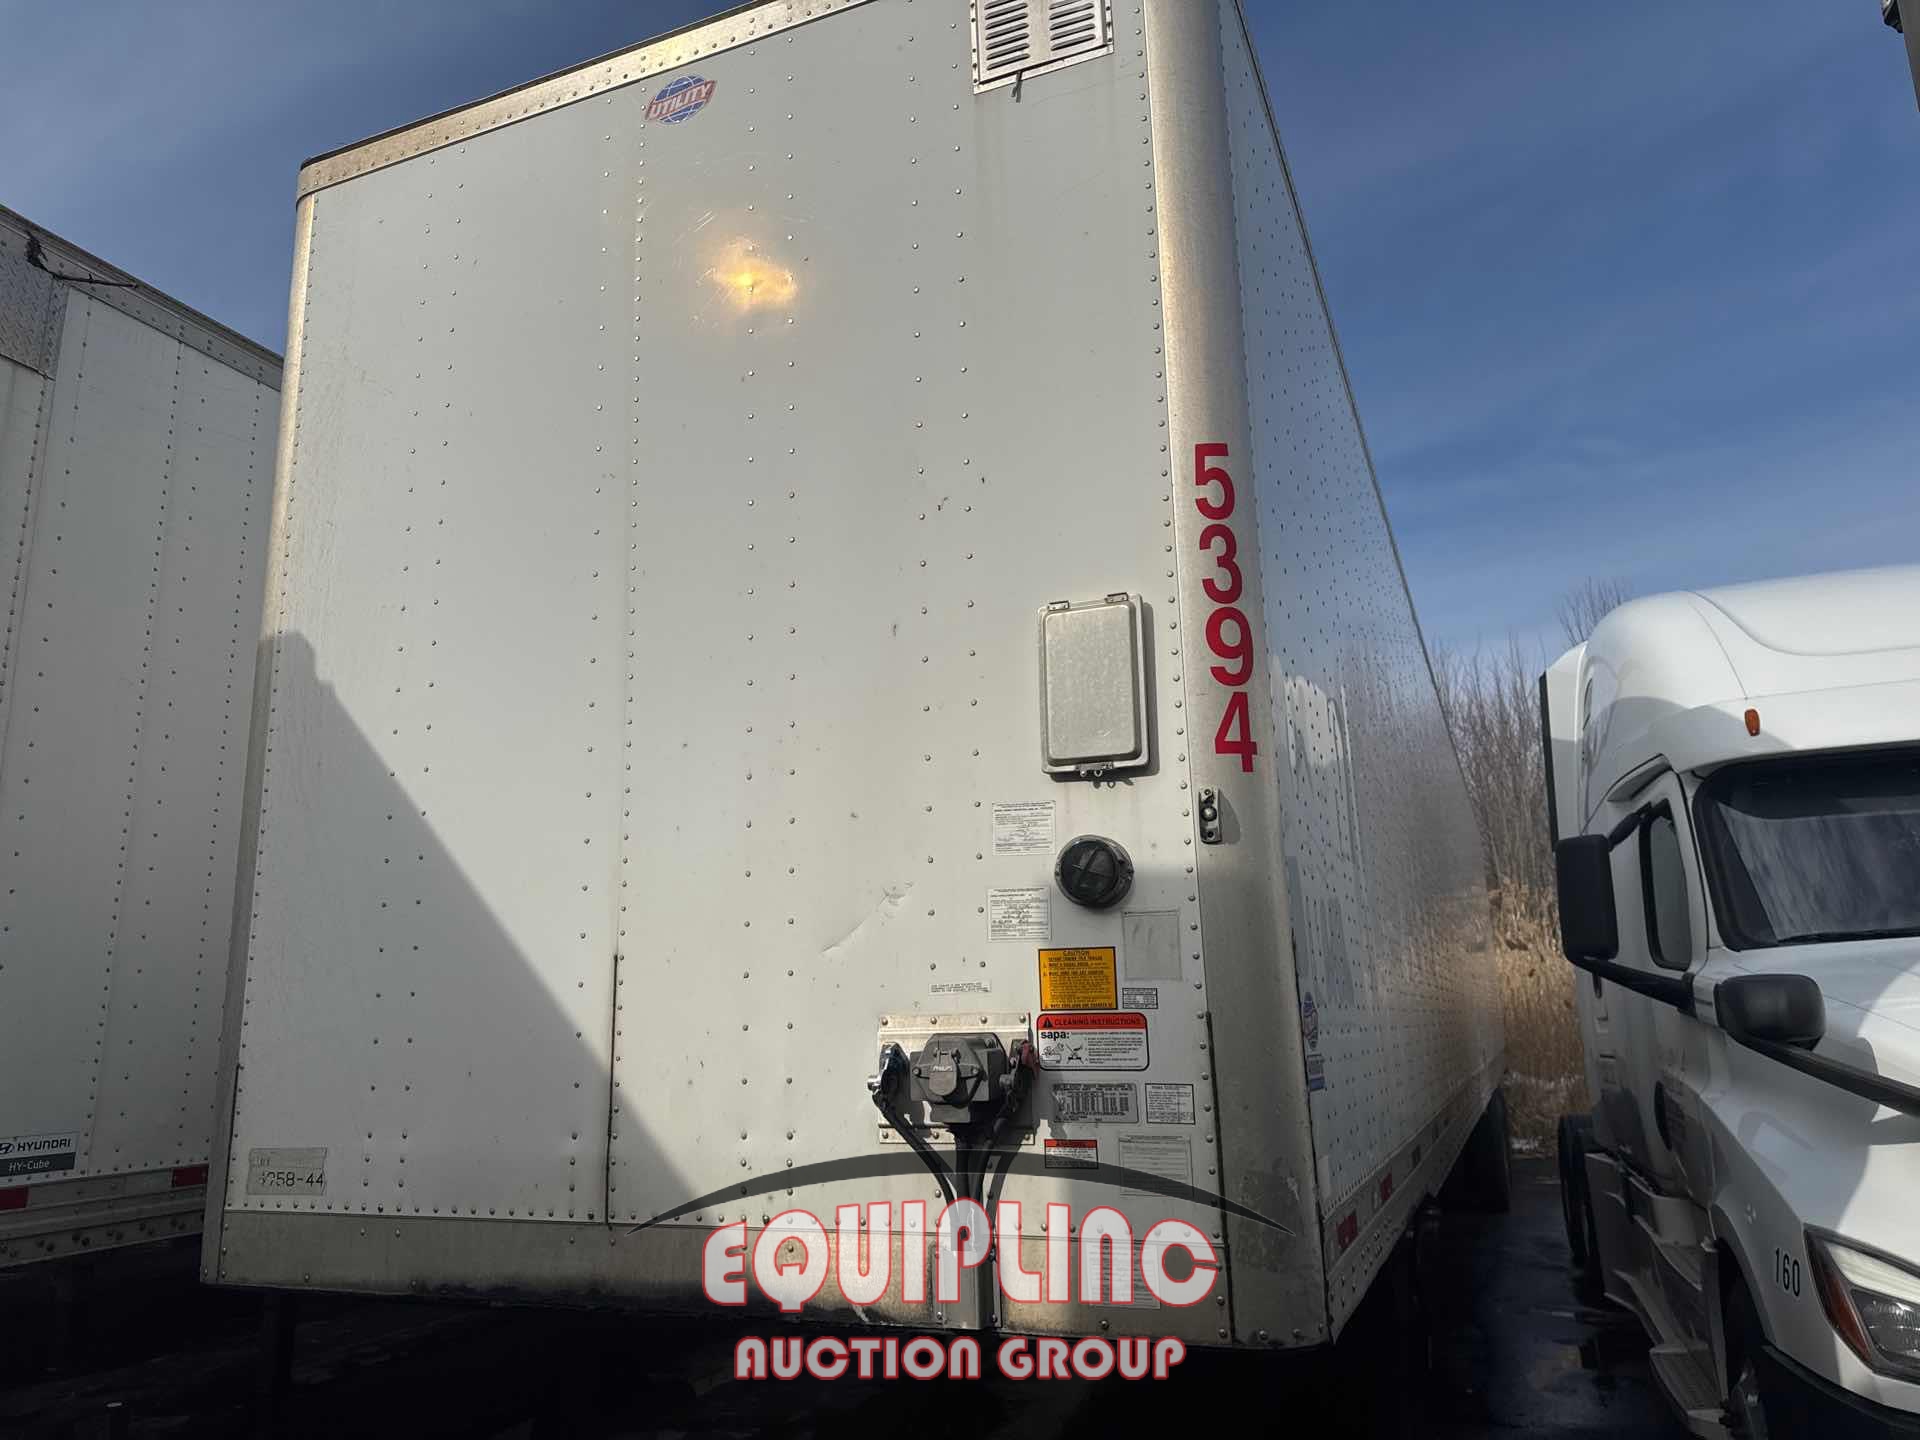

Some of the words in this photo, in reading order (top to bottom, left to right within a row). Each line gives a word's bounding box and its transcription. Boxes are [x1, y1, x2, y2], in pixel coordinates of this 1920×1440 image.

[649, 82, 713, 119] UTILITY
[1194, 443, 1258, 773] 5394
[17, 1139, 71, 1152] HYUNDAI
[9, 1160, 50, 1172] HY-Cube
[1775, 1247, 1801, 1298] 160
